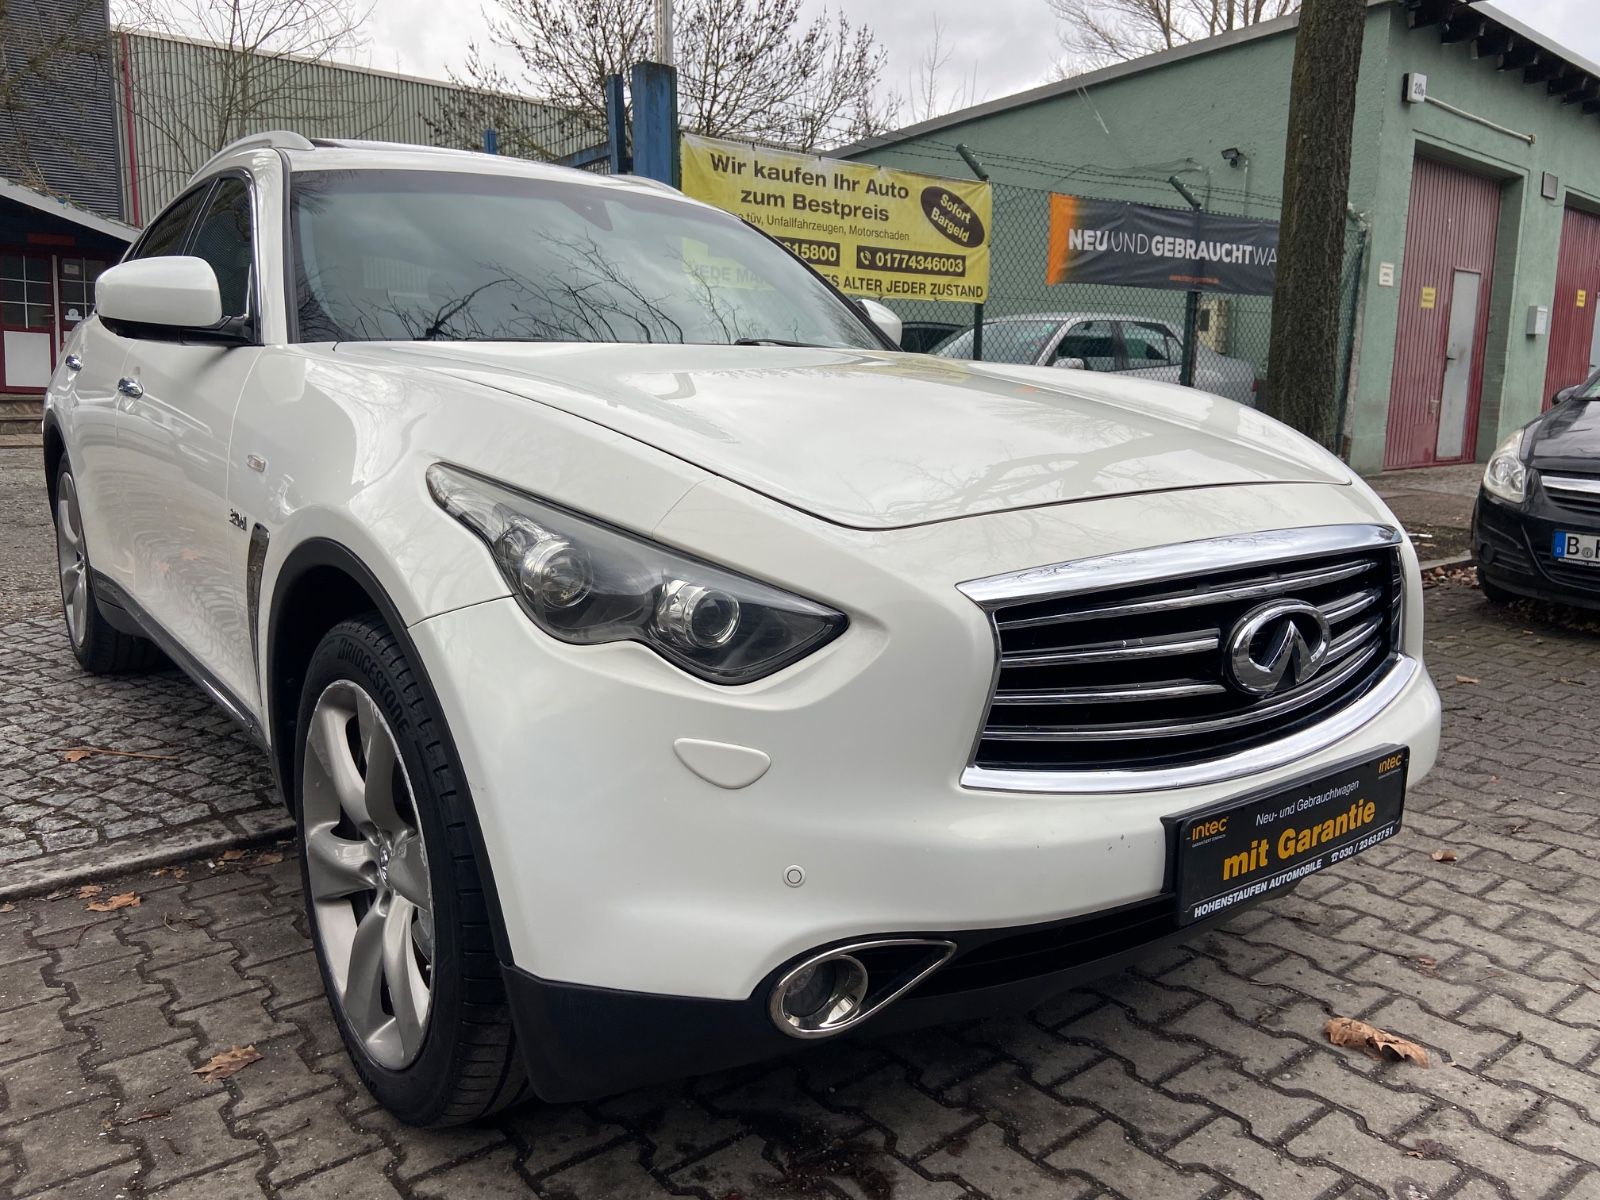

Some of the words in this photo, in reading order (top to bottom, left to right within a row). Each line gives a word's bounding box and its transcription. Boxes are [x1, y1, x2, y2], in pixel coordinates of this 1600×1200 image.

[710, 153, 747, 175] Wir
[754, 160, 827, 187] kaufen
[834, 173, 860, 192] Ihr
[865, 179, 909, 200] Auto
[741, 189, 785, 208] zum
[792, 193, 889, 222] Bestpreis
[940, 194, 971, 224] Sofort
[849, 225, 910, 241] Motorschaden
[930, 207, 970, 243] Bargeld
[875, 251, 964, 273] 01774346003
[844, 276, 882, 292] ALTER
[886, 280, 926, 295] JEDER
[930, 283, 983, 297] ZUSTAND
[1255, 810, 1278, 826] Neu-
[1279, 802, 1295, 819] und
[1296, 780, 1360, 811] Gebrauchtwagen
[1192, 818, 1228, 840] intec
[1222, 839, 1269, 880] mit
[1277, 799, 1376, 860] Garantie
[1194, 882, 1267, 918] HOHENSTAUFEN
[1268, 858, 1322, 890] AUTOMOBILE
